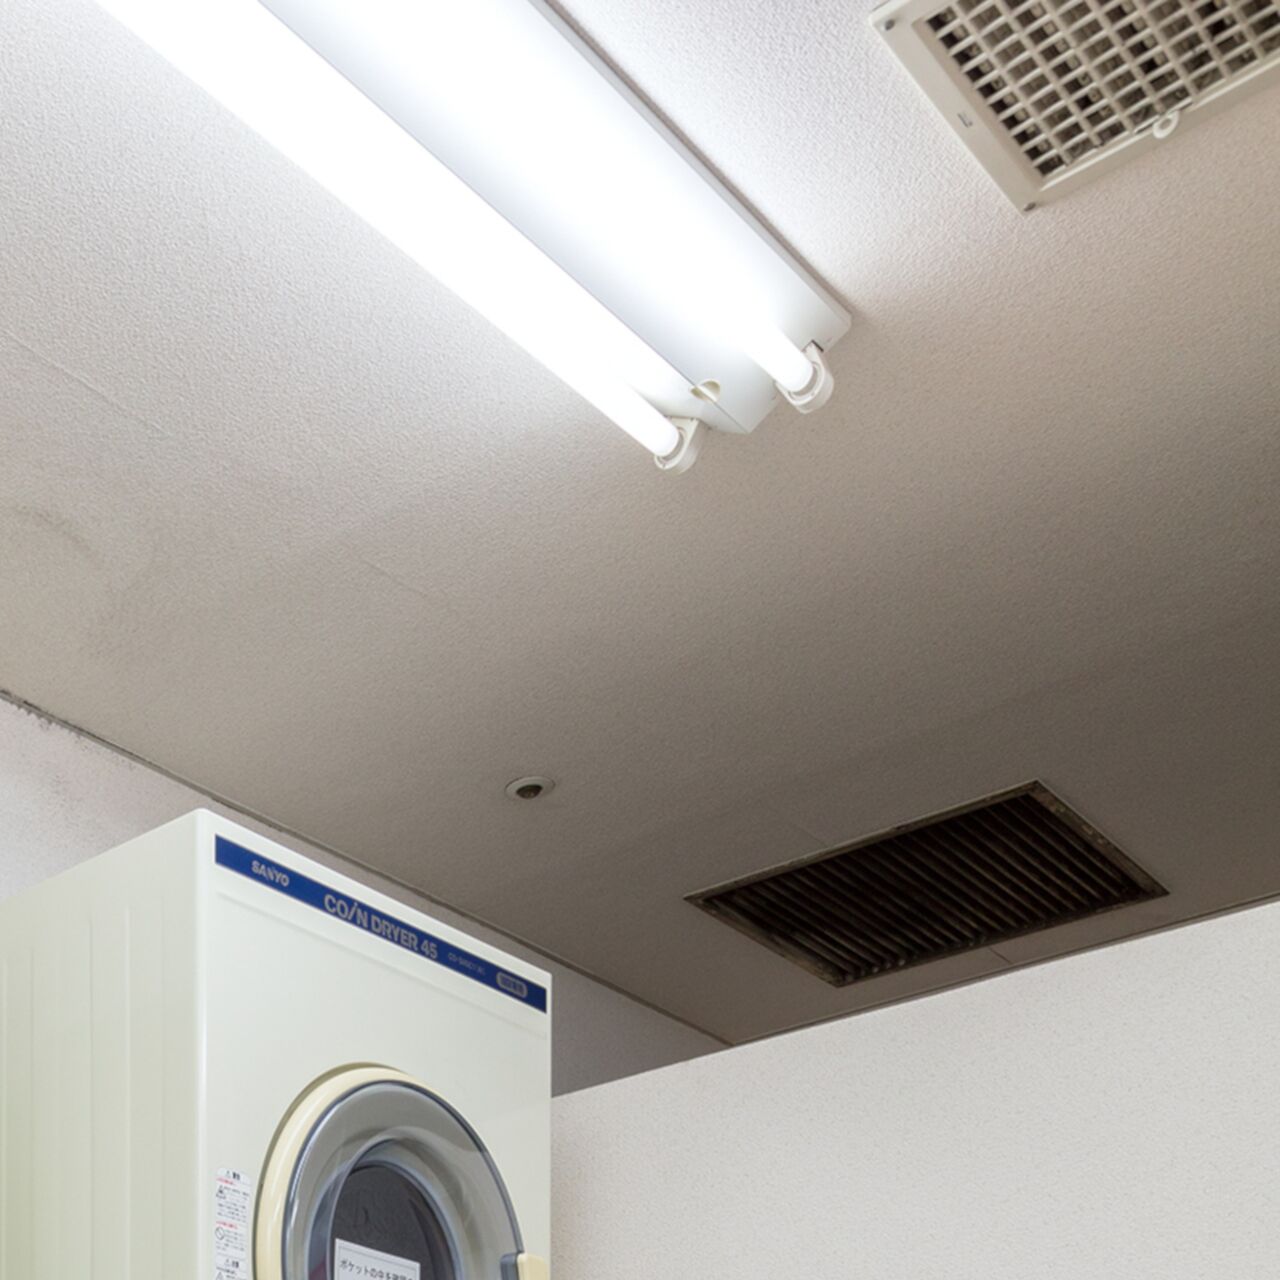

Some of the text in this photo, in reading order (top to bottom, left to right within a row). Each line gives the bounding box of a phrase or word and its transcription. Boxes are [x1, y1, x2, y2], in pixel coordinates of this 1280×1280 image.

[251, 859, 290, 887] SANYO
[371, 914, 418, 950] DRYER
[420, 939, 438, 961] 45
